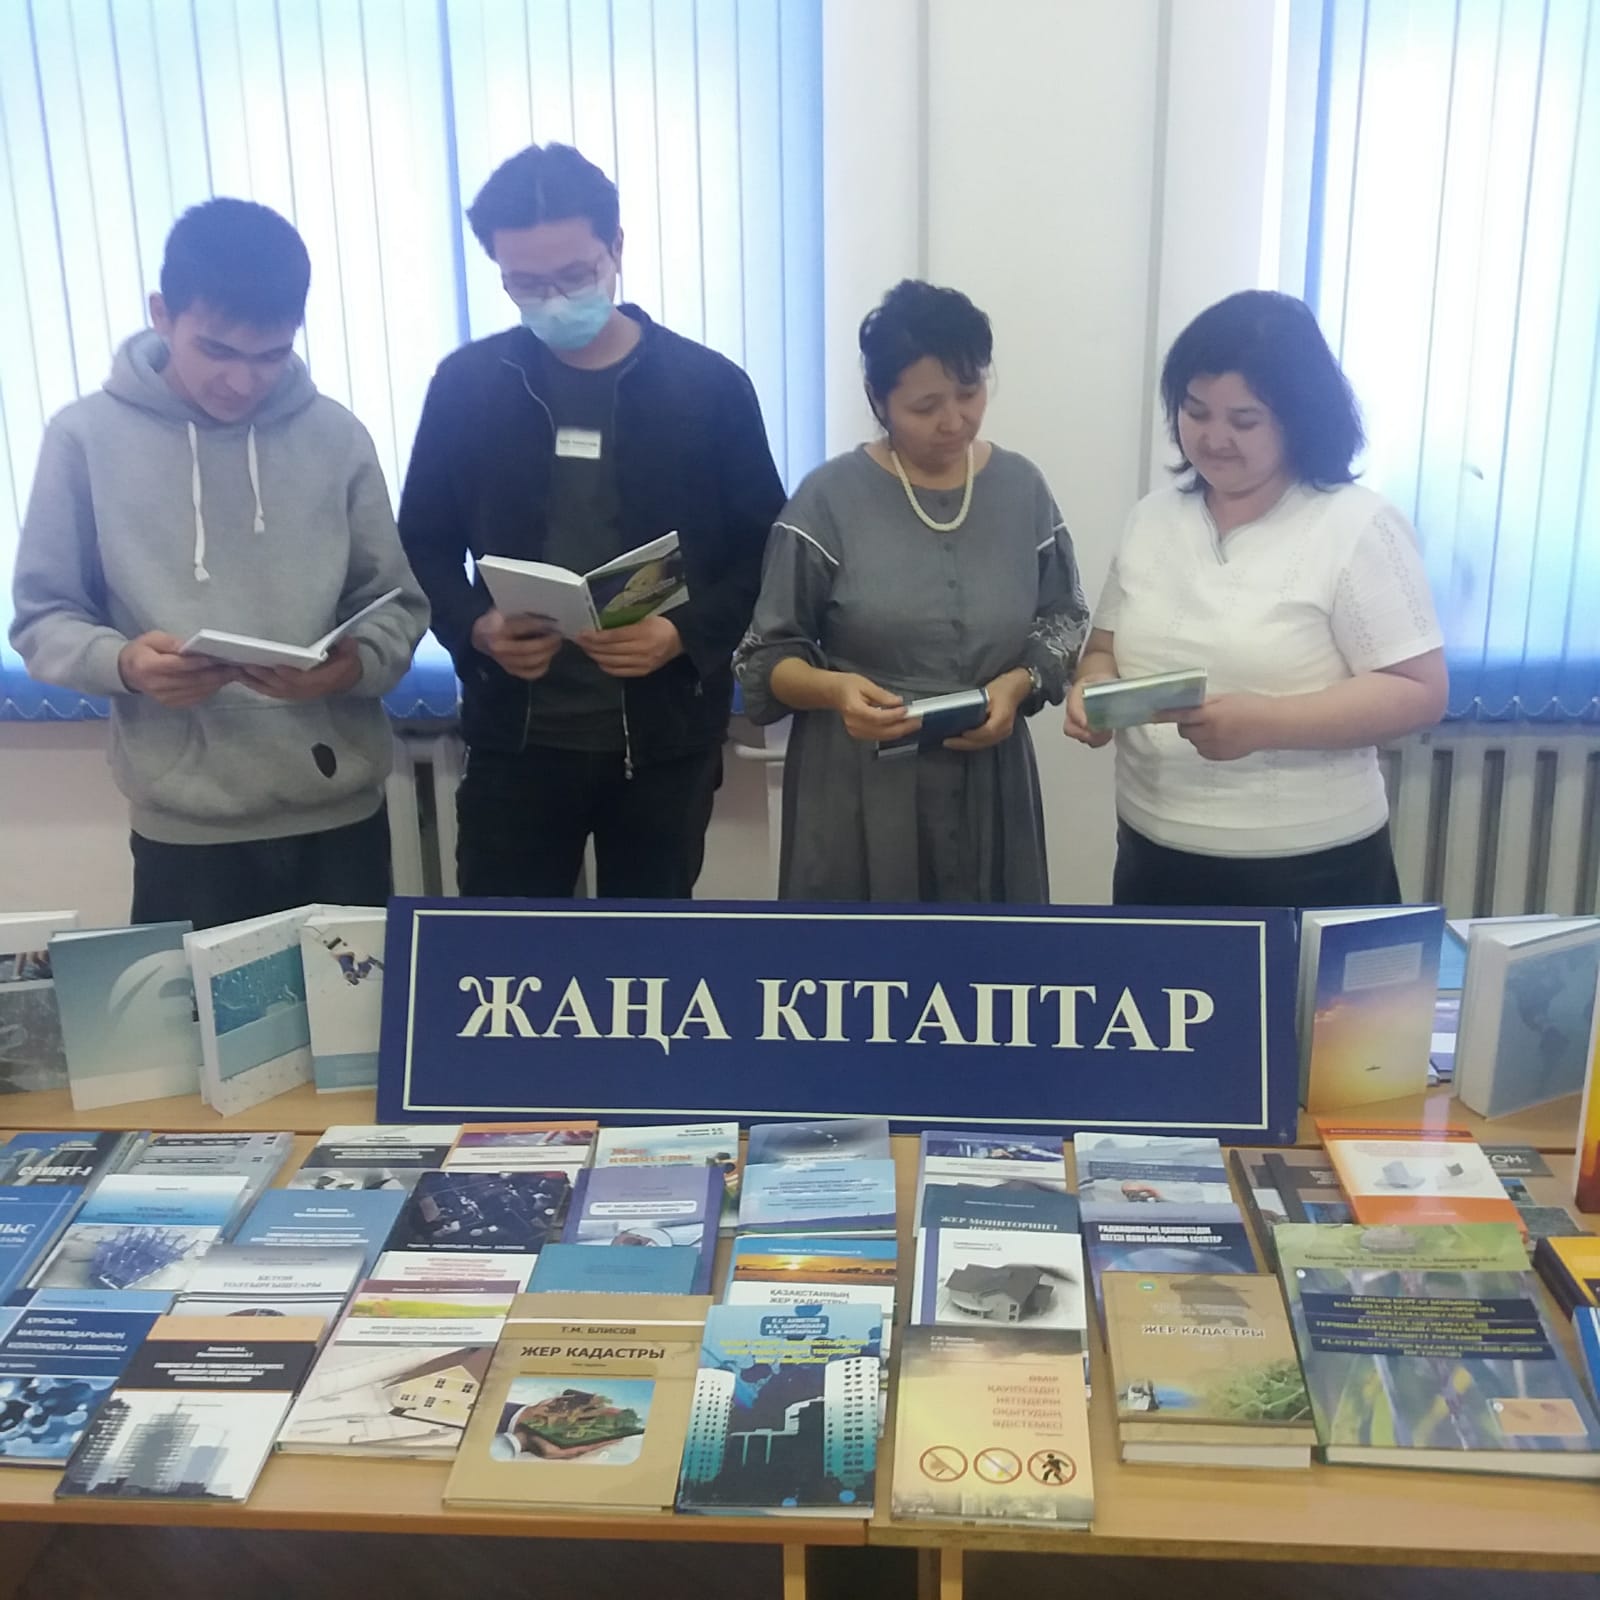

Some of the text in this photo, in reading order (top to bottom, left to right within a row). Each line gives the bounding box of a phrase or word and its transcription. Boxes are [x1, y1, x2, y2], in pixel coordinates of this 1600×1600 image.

[456, 976, 1215, 1055] ЖАҢА КІТАПТАР
[1143, 1324, 1266, 1338] ЖЕР КАДАСТРЫ
[519, 1346, 666, 1360] ЖЕР КАДАСТРЫ
